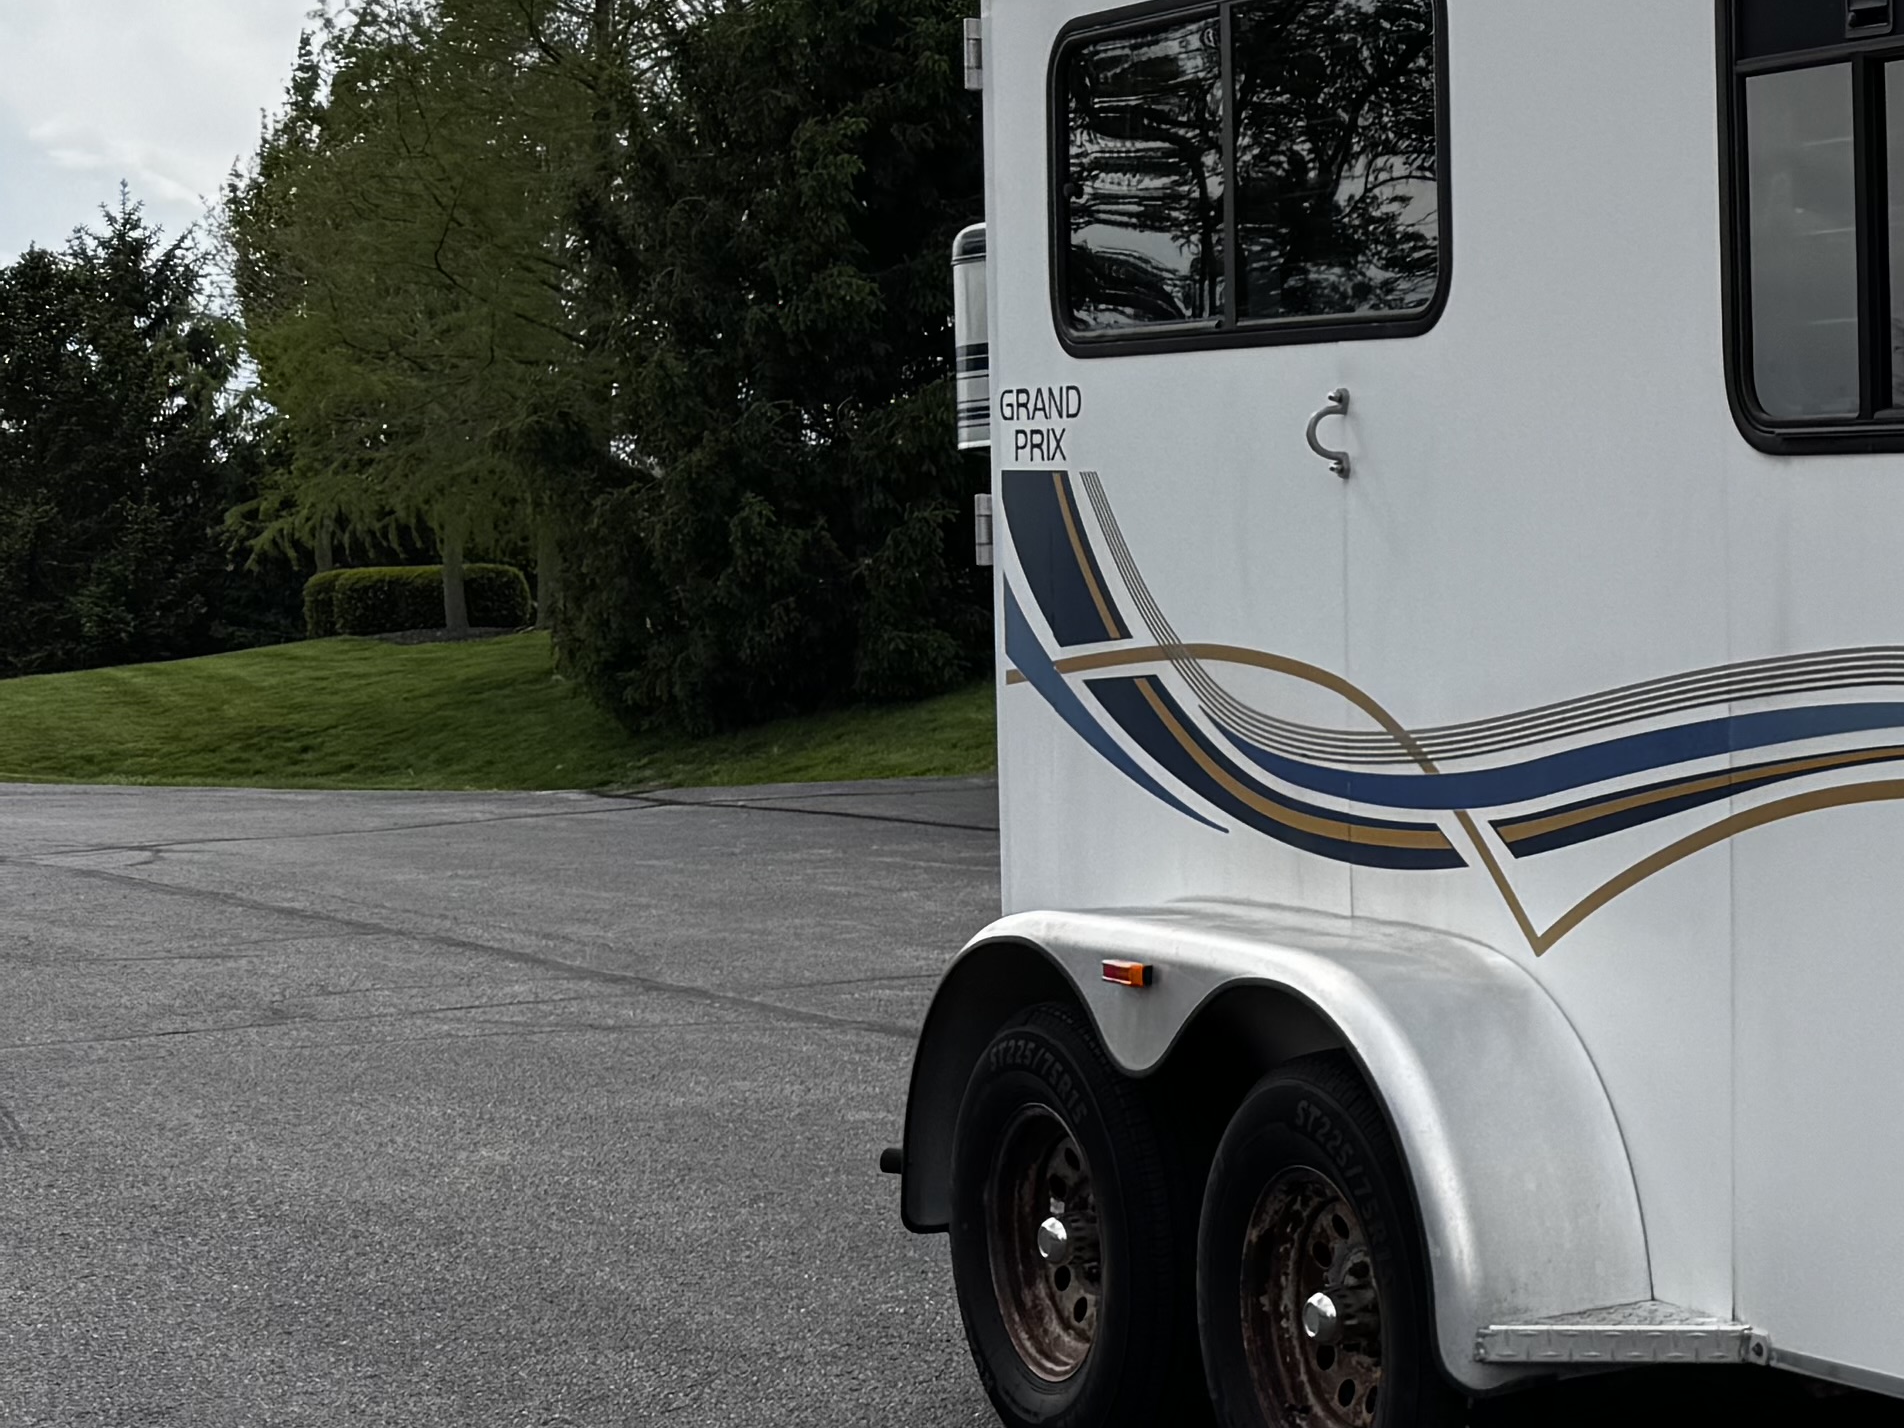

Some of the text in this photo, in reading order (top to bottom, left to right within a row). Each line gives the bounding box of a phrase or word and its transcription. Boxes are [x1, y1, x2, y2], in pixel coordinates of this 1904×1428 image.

[1000, 385, 1082, 421] GRAND
[1015, 428, 1067, 462] PRIX
[989, 1038, 1088, 1125] ST225/75R15
